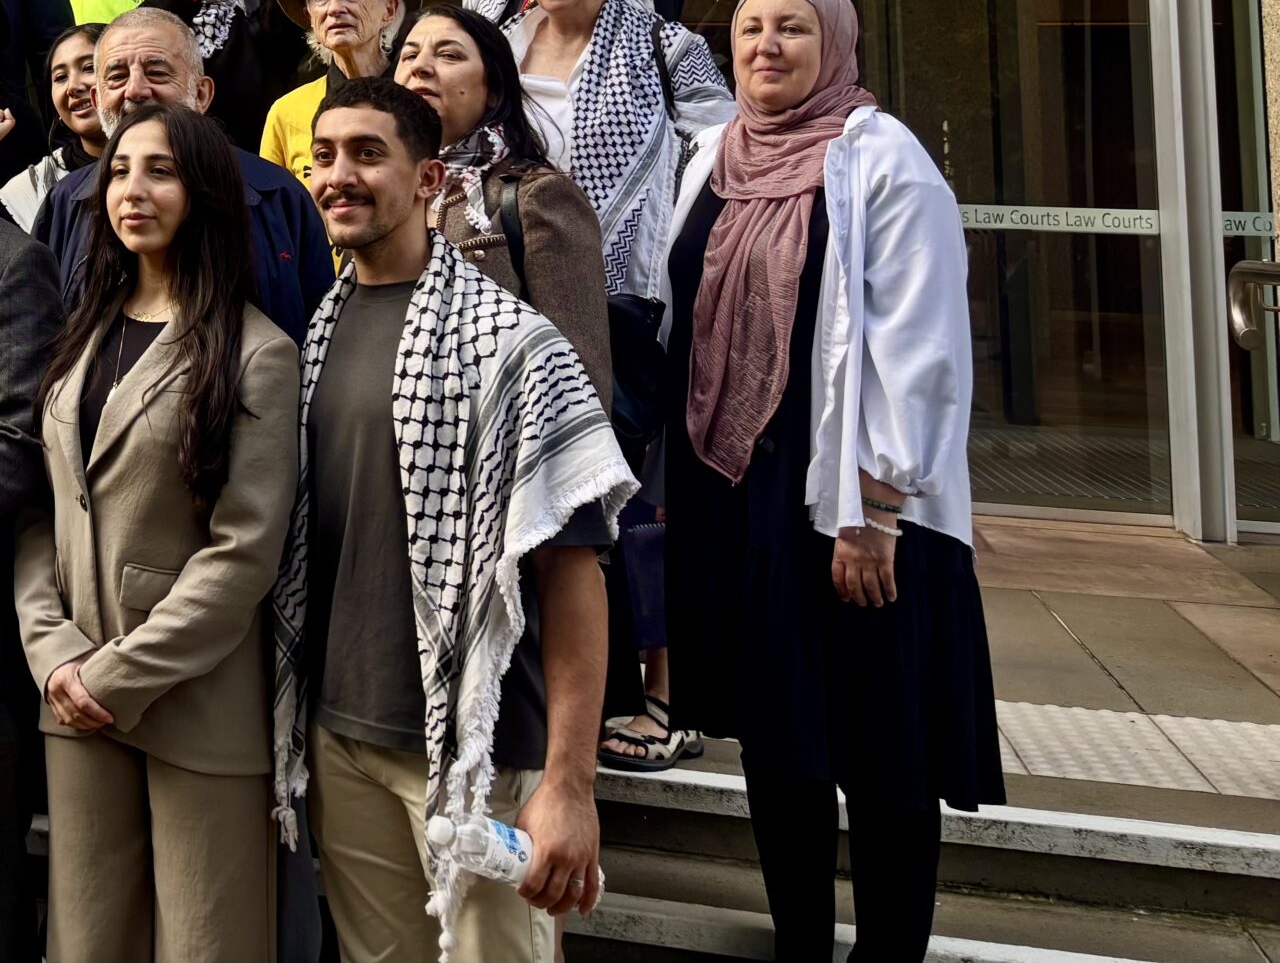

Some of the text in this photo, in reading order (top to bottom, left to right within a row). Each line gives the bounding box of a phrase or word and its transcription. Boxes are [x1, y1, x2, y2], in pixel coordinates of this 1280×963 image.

[974, 208, 1005, 225] Law
[1010, 209, 1061, 227] Courts
[1065, 211, 1096, 228] Law
[1101, 212, 1154, 230] Courts
[1224, 217, 1247, 232] aw
